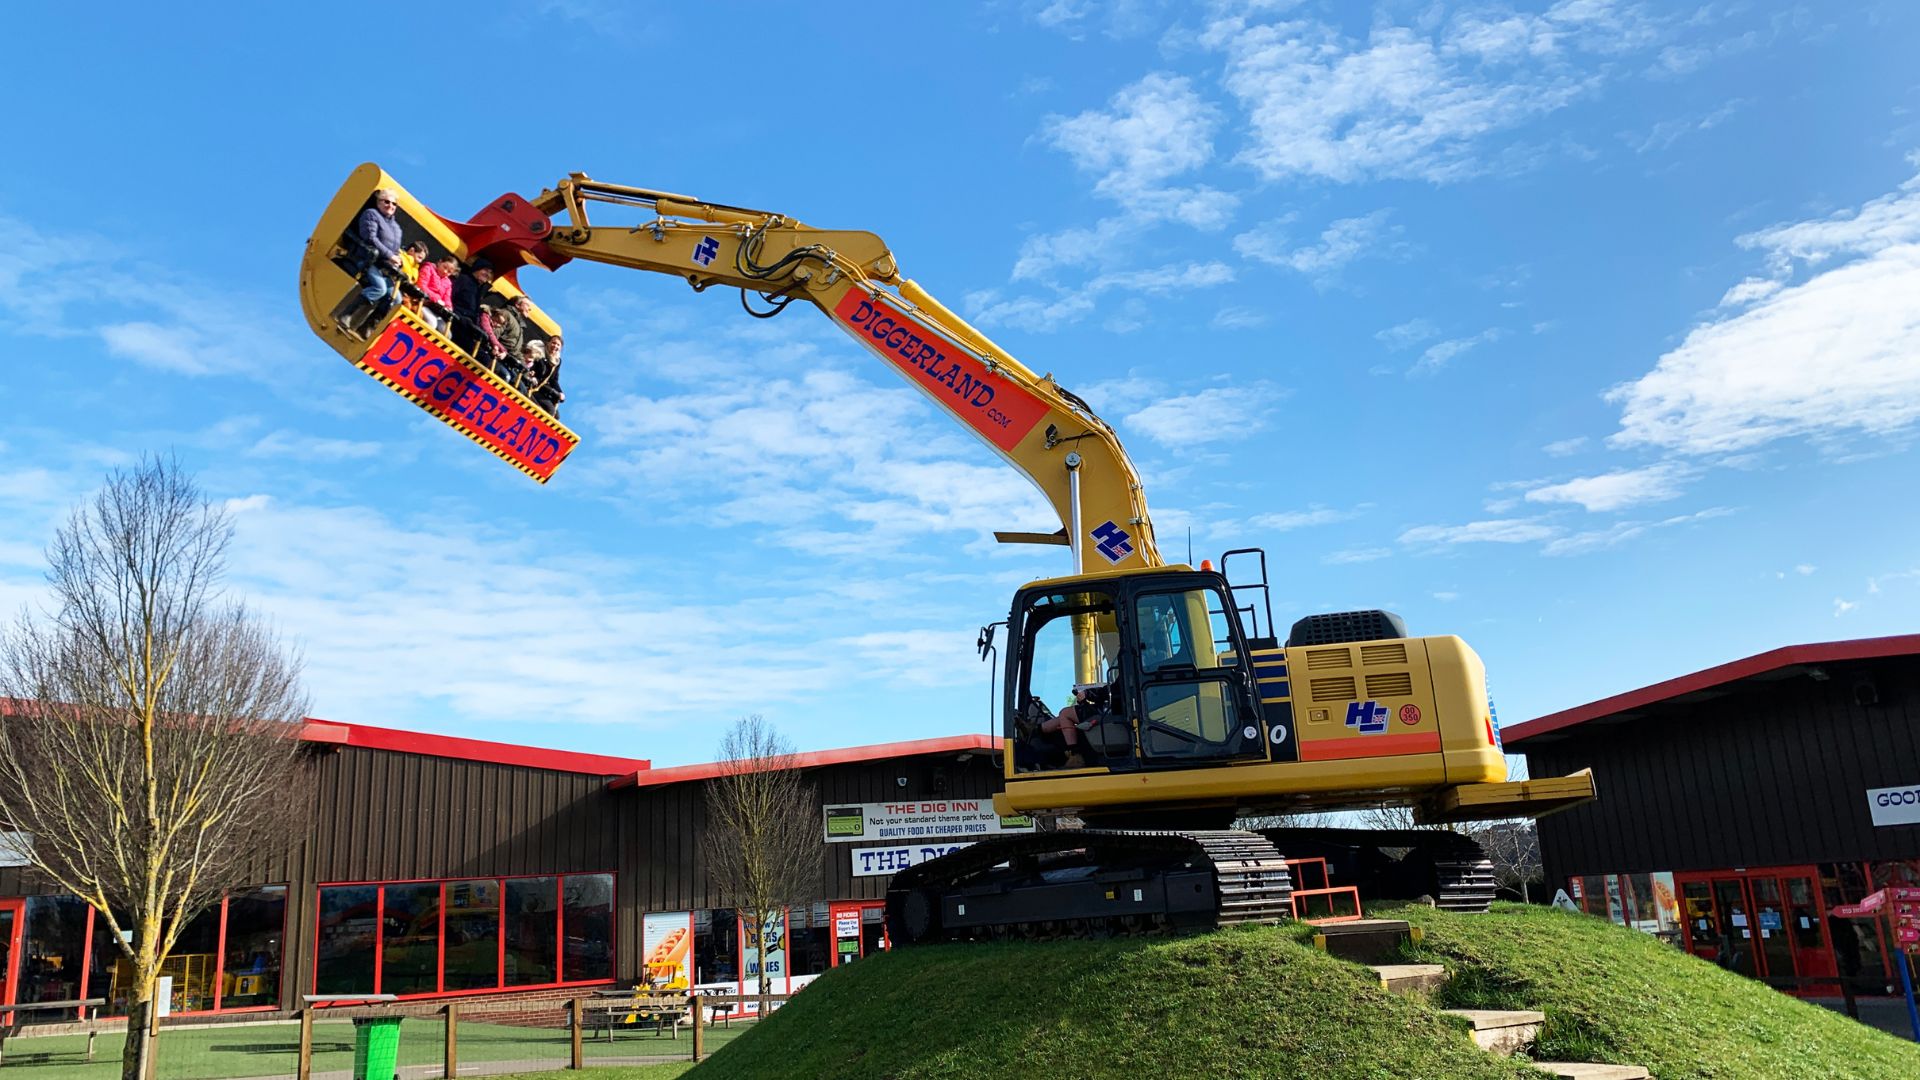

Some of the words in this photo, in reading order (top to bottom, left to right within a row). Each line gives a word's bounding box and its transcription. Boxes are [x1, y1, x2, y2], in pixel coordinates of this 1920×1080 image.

[378, 332, 560, 465] DIGGERLAND
[885, 804, 916, 815] THE
[921, 803, 947, 813] DIG
[952, 802, 979, 812] INN
[870, 817, 885, 825] Not
[886, 818, 903, 826] your
[905, 815, 937, 824] standard
[939, 814, 961, 822] theme
[962, 813, 978, 822] park
[980, 812, 995, 820] food
[880, 828, 906, 837] QUALITY
[908, 826, 925, 836] FOOD
[926, 825, 934, 835] AT
[935, 825, 963, 834] CHEAPER
[965, 823, 987, 832] PRICES
[860, 849, 910, 871] THE
